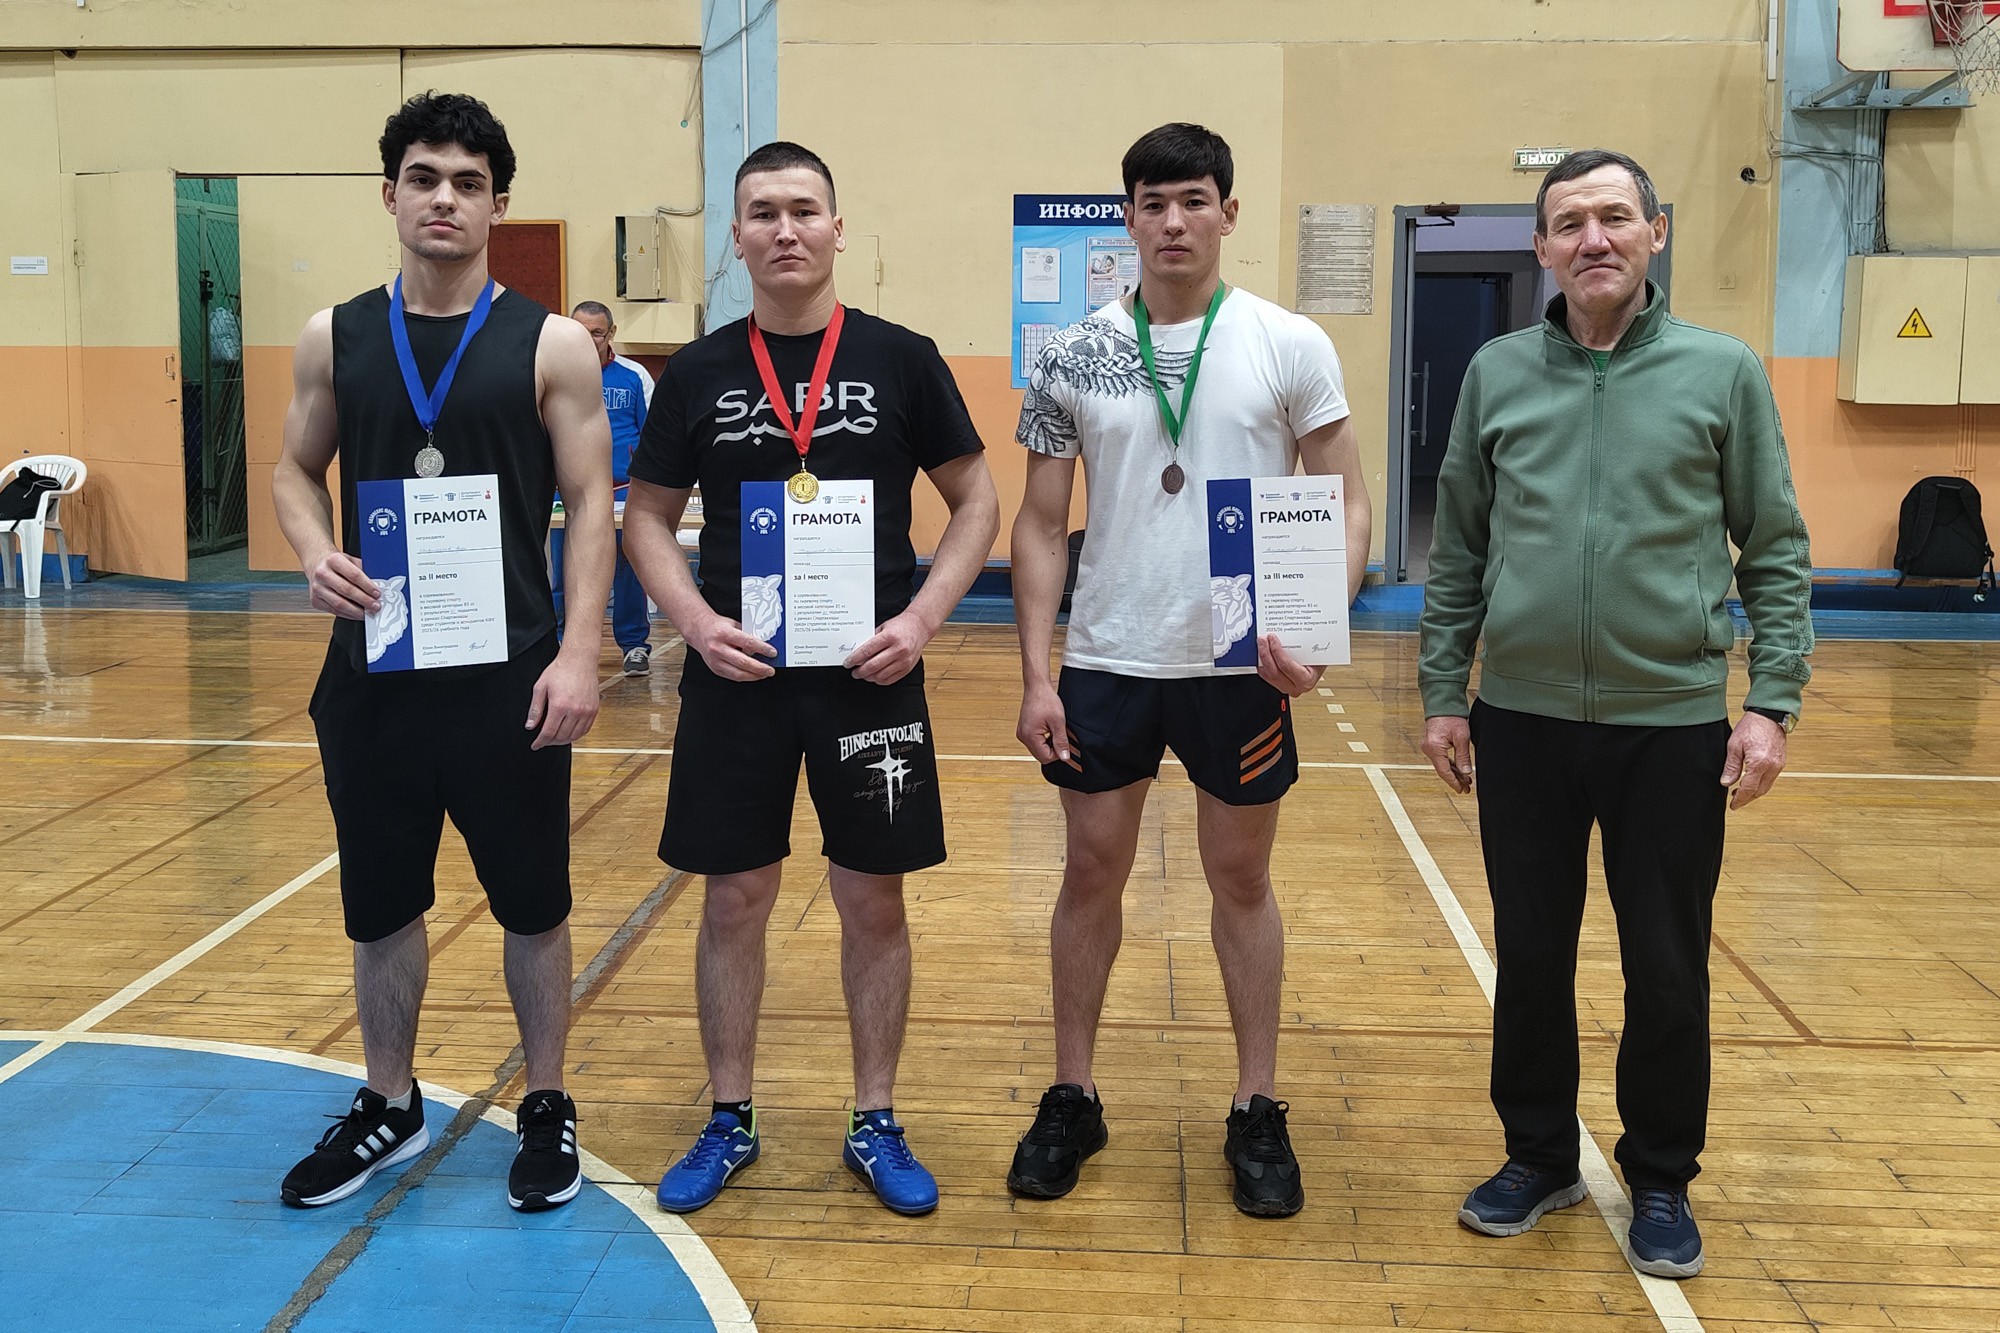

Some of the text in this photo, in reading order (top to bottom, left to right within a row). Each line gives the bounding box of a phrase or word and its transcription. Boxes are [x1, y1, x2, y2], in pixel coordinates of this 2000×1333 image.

[1039, 204, 1126, 218] ИНФОРМ
[414, 509, 487, 525] ГРАМОТА
[793, 513, 861, 525] ГРАМОТА
[1260, 510, 1332, 523] ГРАМОТА
[838, 722, 924, 762] HINGCHVOLING
